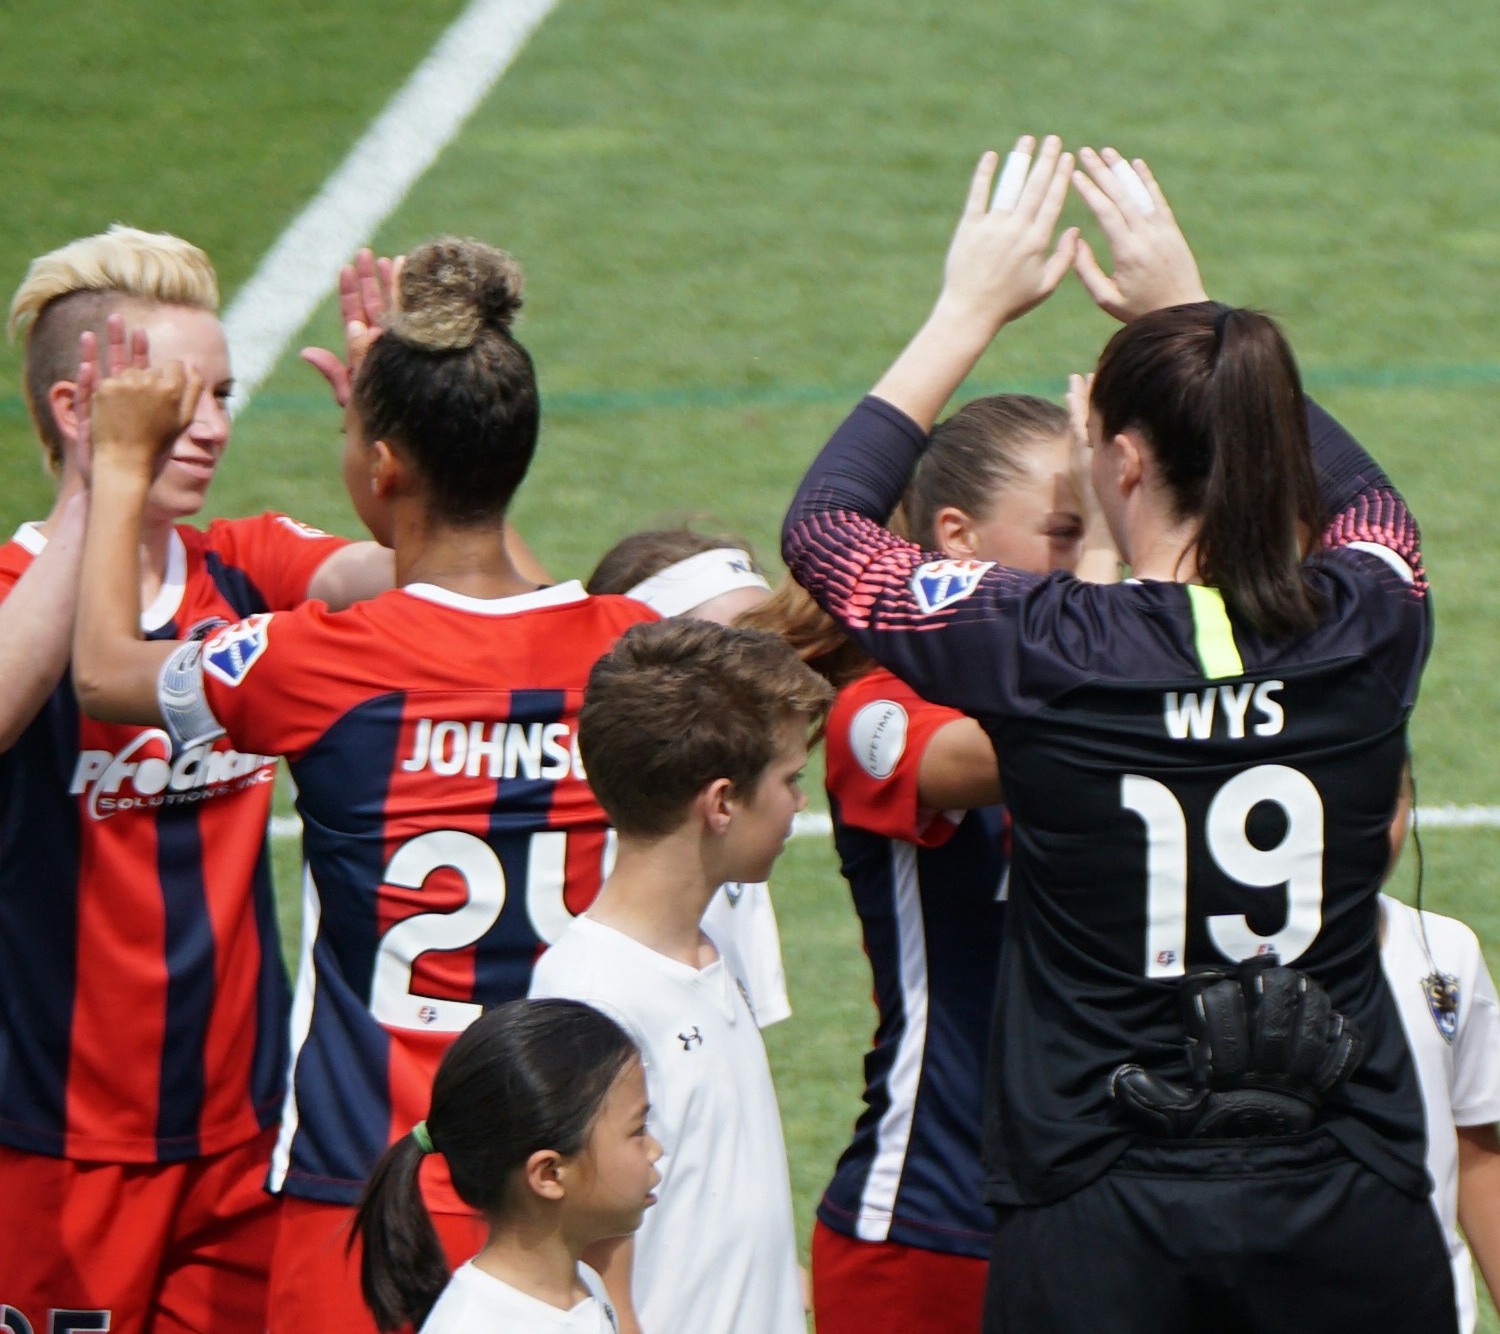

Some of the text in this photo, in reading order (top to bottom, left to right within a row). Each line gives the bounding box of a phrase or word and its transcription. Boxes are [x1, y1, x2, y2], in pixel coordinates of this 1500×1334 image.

[1163, 679, 1285, 740] WYS
[402, 718, 589, 781] JOHNS
[1120, 763, 1325, 978] 19
